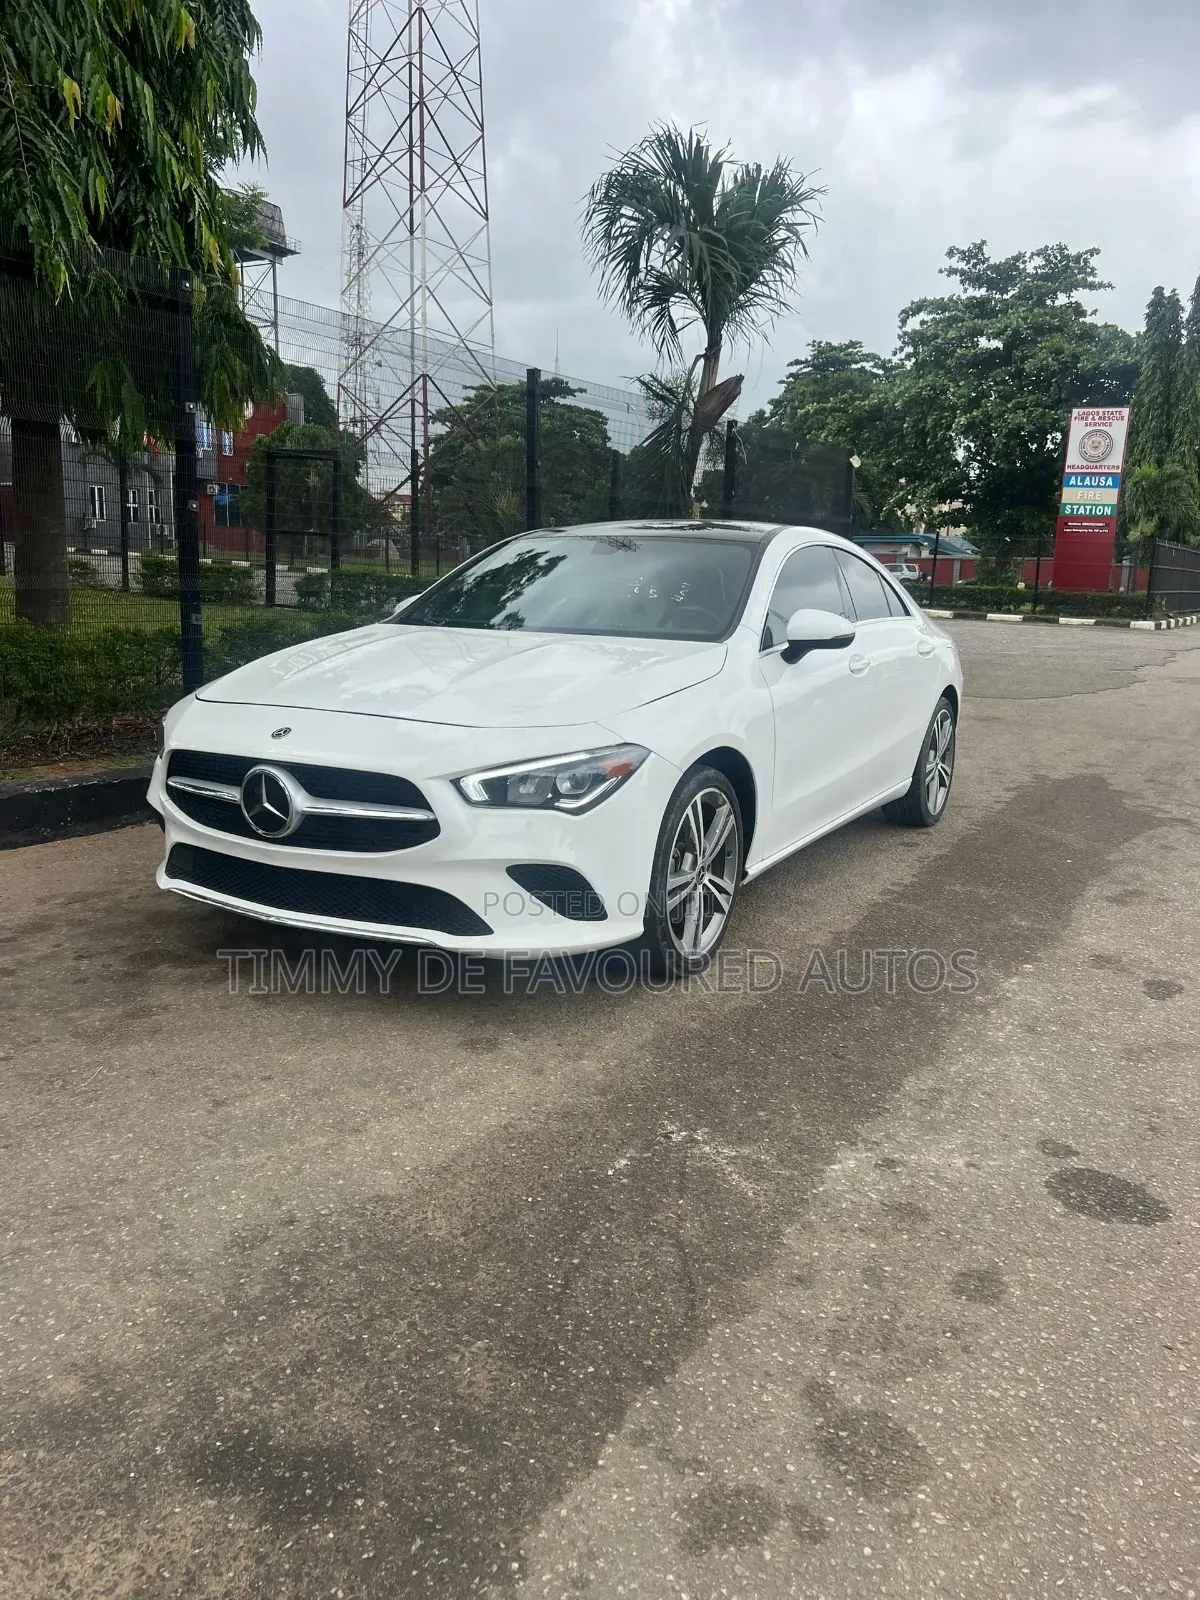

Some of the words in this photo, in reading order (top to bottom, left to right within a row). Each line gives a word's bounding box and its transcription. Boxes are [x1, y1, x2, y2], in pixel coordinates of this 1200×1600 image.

[1069, 475, 1113, 487] ALAUSA
[1077, 490, 1103, 501] FIRE
[1064, 504, 1112, 516] STATION
